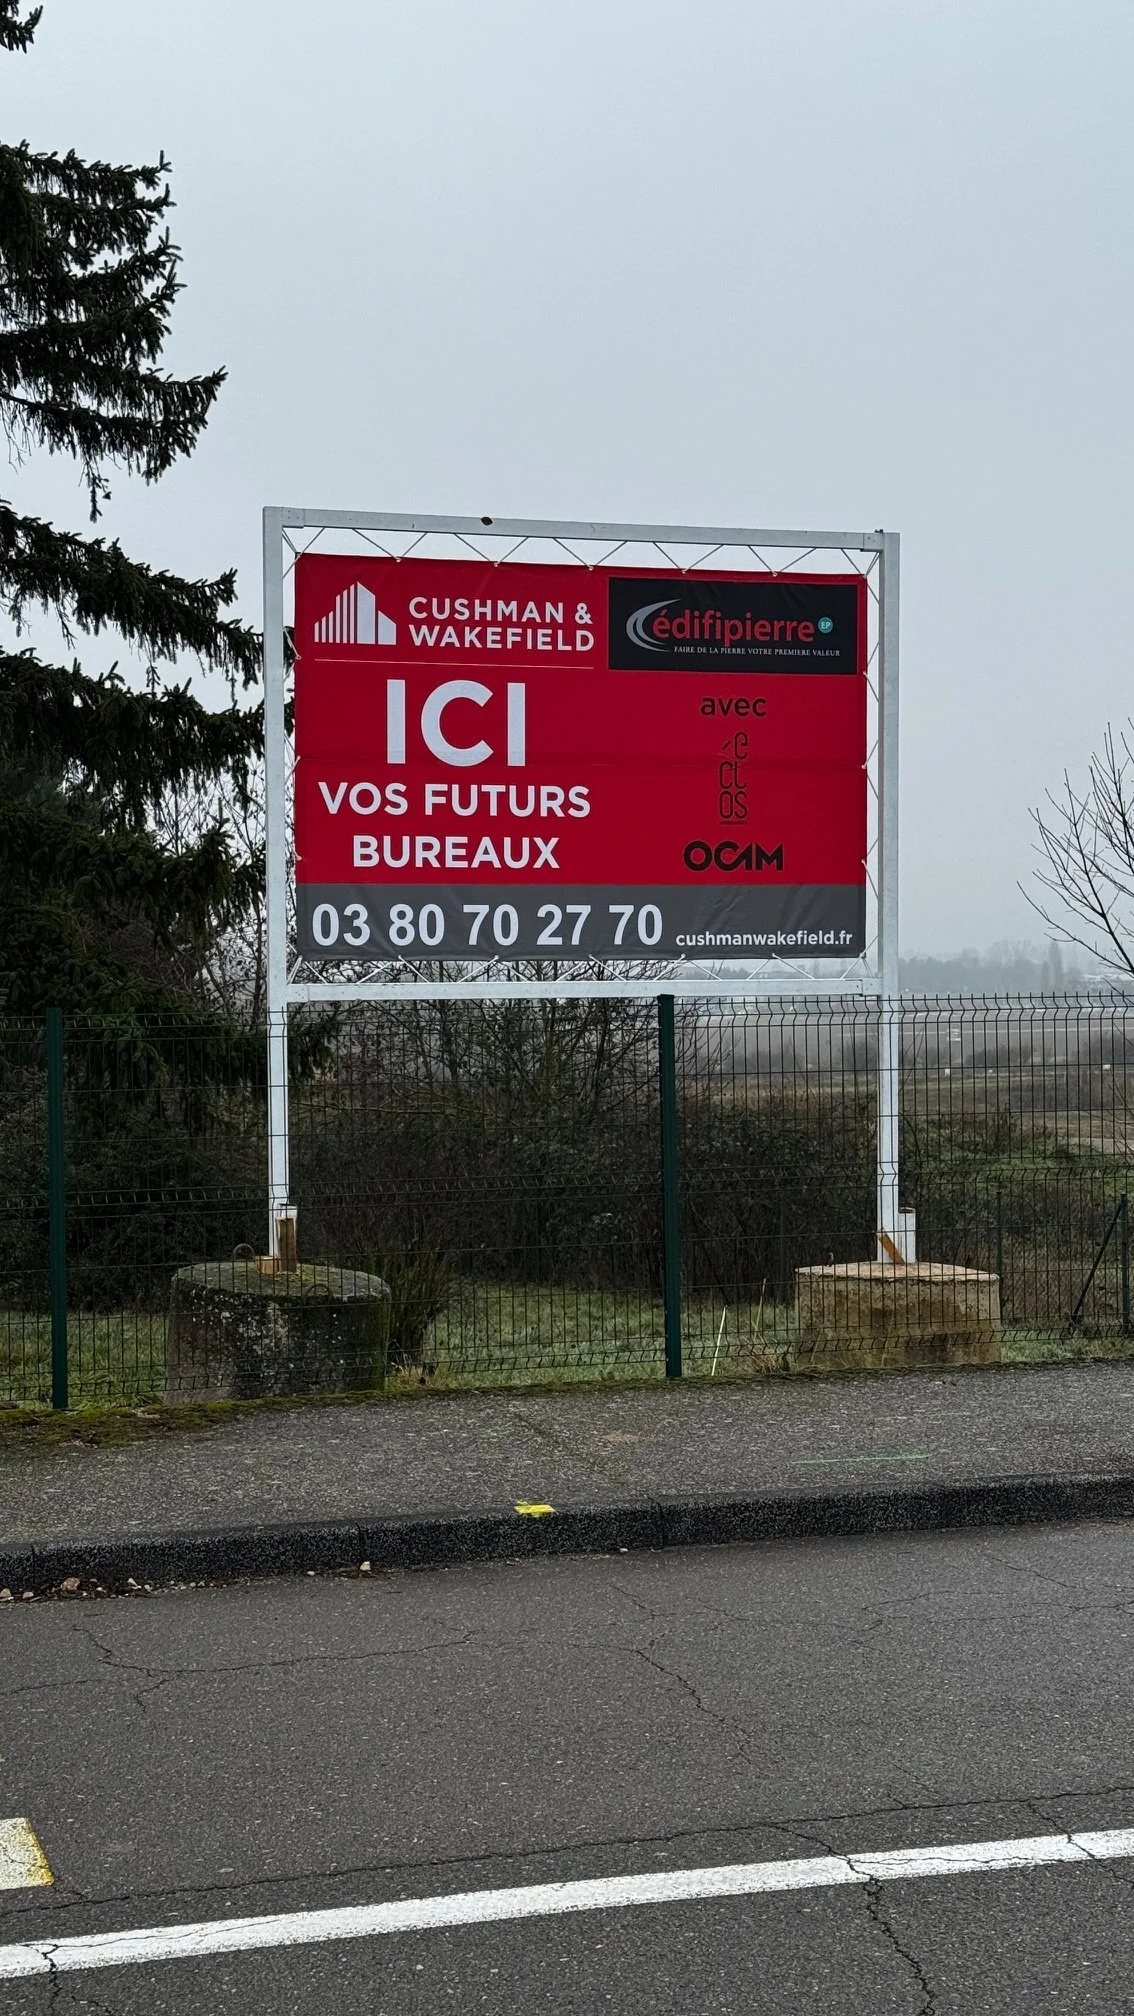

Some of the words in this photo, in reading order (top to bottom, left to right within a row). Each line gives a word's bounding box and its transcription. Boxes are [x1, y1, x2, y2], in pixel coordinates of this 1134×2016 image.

[408, 596, 564, 624] CUSHMAN
[574, 602, 593, 624] &
[820, 621, 831, 630] EP
[408, 624, 594, 651] WAKEFIELD
[653, 609, 815, 647] édifipierre
[674, 646, 695, 654] FAIRE
[697, 646, 707, 654] DE
[720, 647, 746, 655] PIERRE
[747, 648, 773, 656] VOTRE
[812, 649, 841, 657] VALEUR
[386, 679, 526, 767] ICI
[700, 697, 768, 717] avec
[318, 782, 408, 815] VOS
[424, 783, 591, 818] FUTURS
[352, 835, 560, 869] BUREAUX
[683, 840, 784, 872] OCAM
[312, 903, 371, 946] 03
[388, 903, 445, 946] 80
[462, 903, 520, 946] 70
[536, 903, 592, 946] 27
[608, 904, 663, 946] 70
[675, 930, 853, 947] cushmanwakefield.fr
